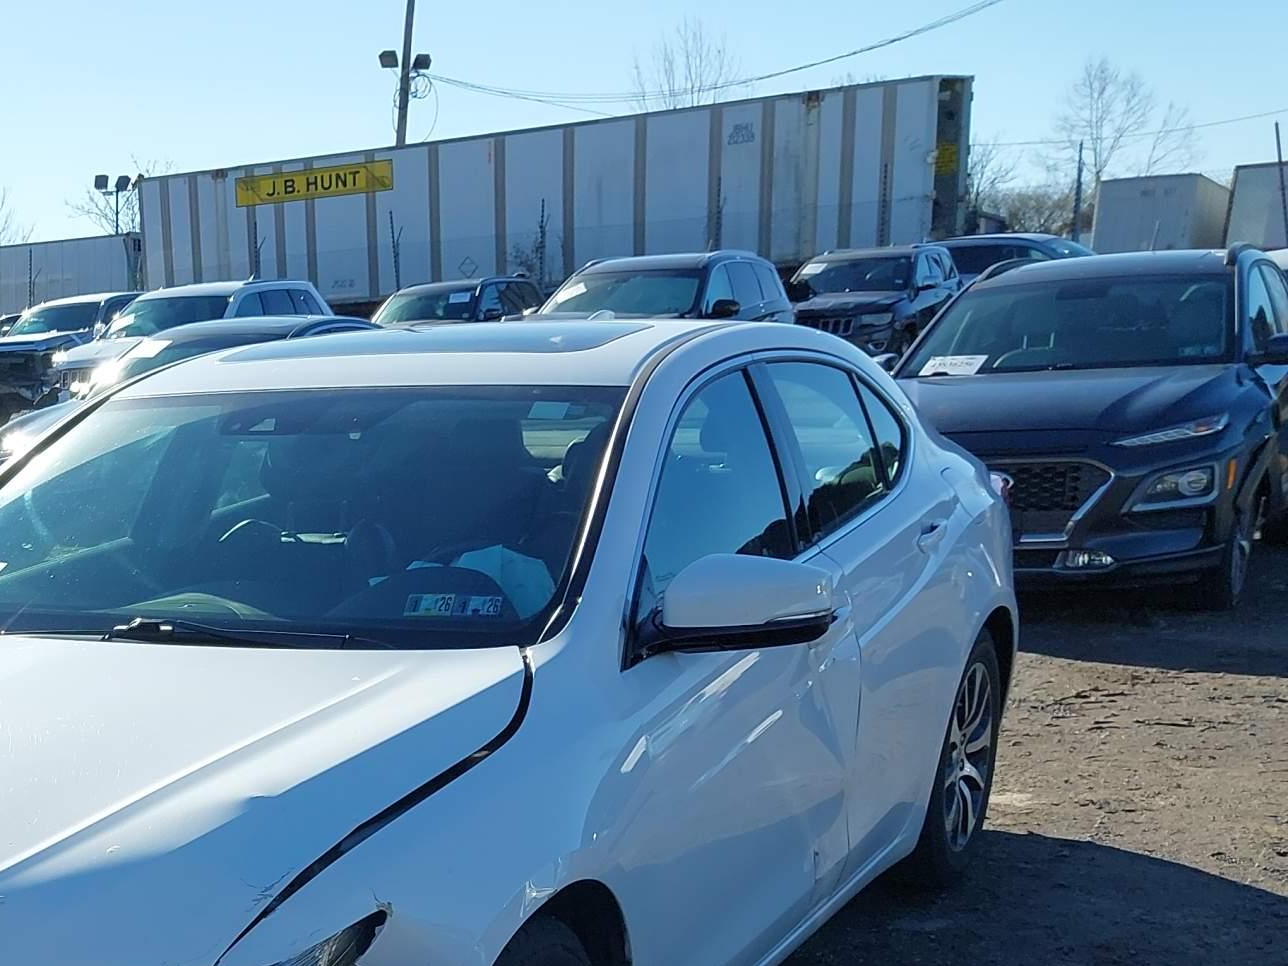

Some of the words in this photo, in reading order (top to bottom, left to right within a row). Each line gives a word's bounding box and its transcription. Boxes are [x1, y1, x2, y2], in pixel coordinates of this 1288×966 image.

[266, 178, 301, 197] J.B.
[306, 170, 361, 192] HUNT
[438, 596, 452, 612] 26
[487, 598, 500, 613] 26
